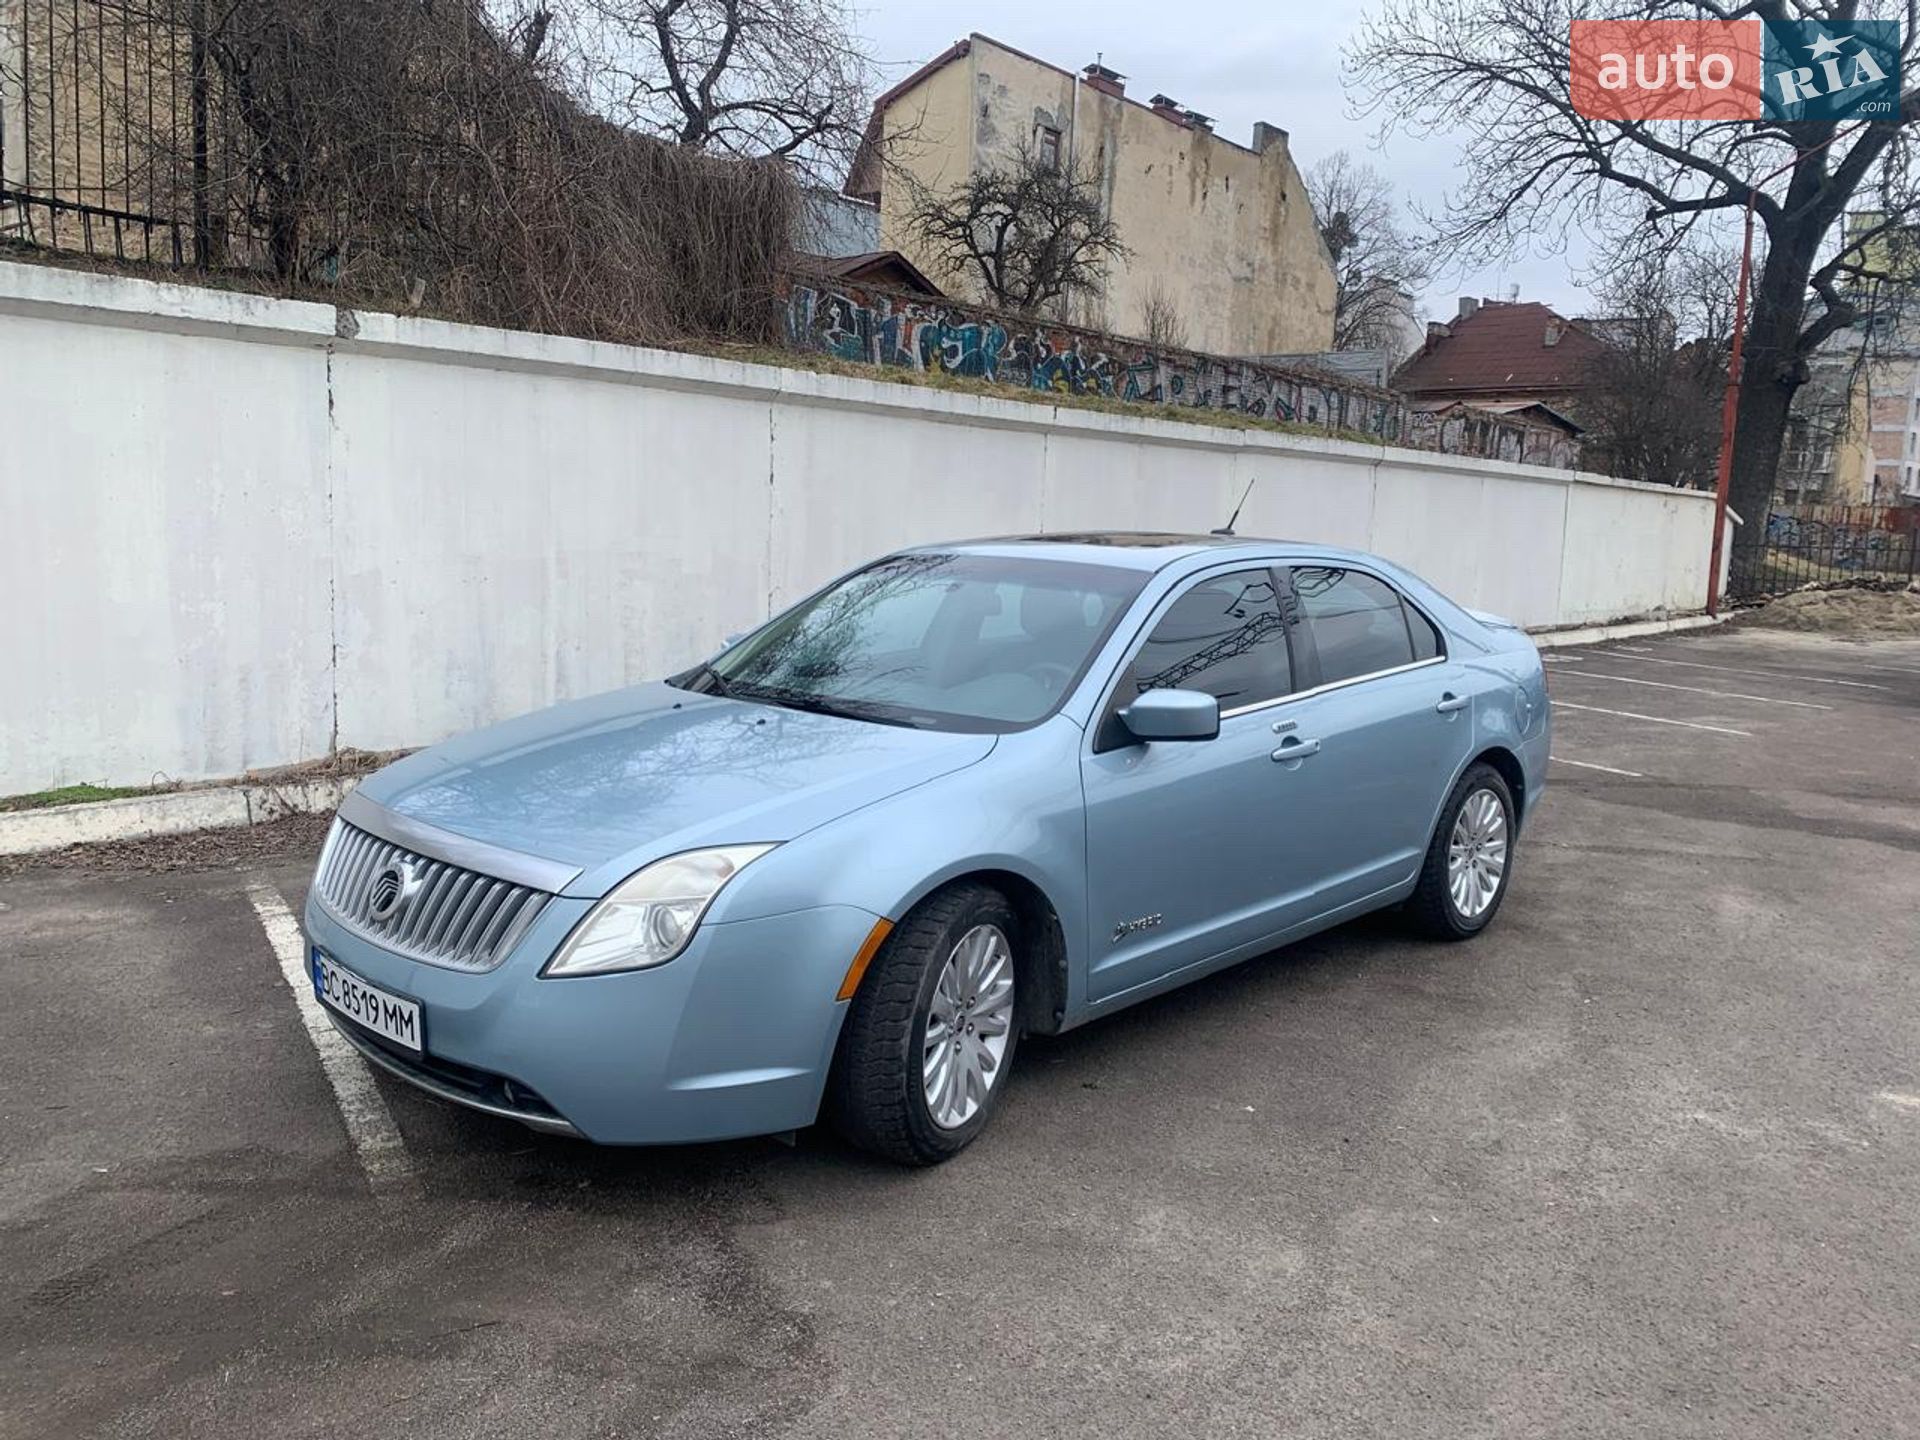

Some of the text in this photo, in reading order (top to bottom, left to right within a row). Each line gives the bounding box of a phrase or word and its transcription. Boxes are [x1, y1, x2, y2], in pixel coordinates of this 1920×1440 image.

[321, 961, 341, 1001] BC
[342, 979, 379, 1025] 8519
[382, 999, 415, 1042] MM
